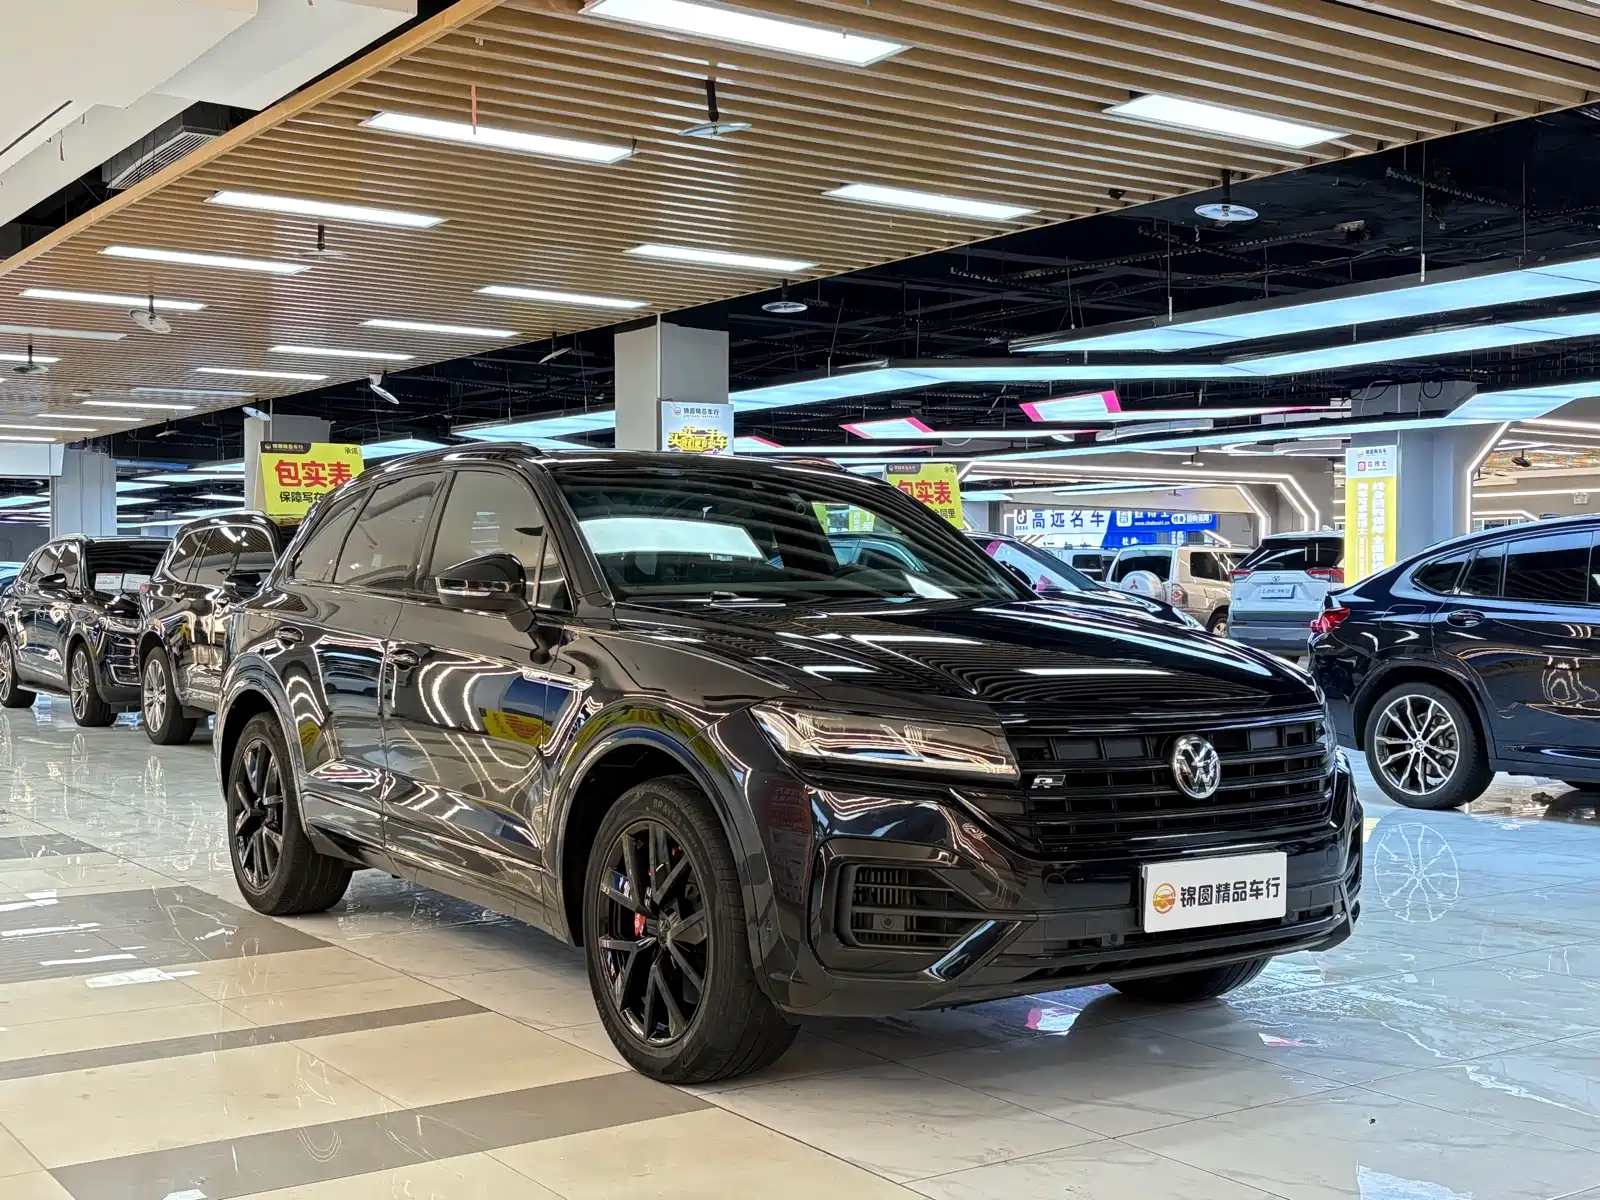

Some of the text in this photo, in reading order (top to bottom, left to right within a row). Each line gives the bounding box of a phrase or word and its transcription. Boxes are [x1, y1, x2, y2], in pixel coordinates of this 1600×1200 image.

[275, 460, 352, 488] 包实表
[1180, 877, 1280, 908] 锦圆精品车行
